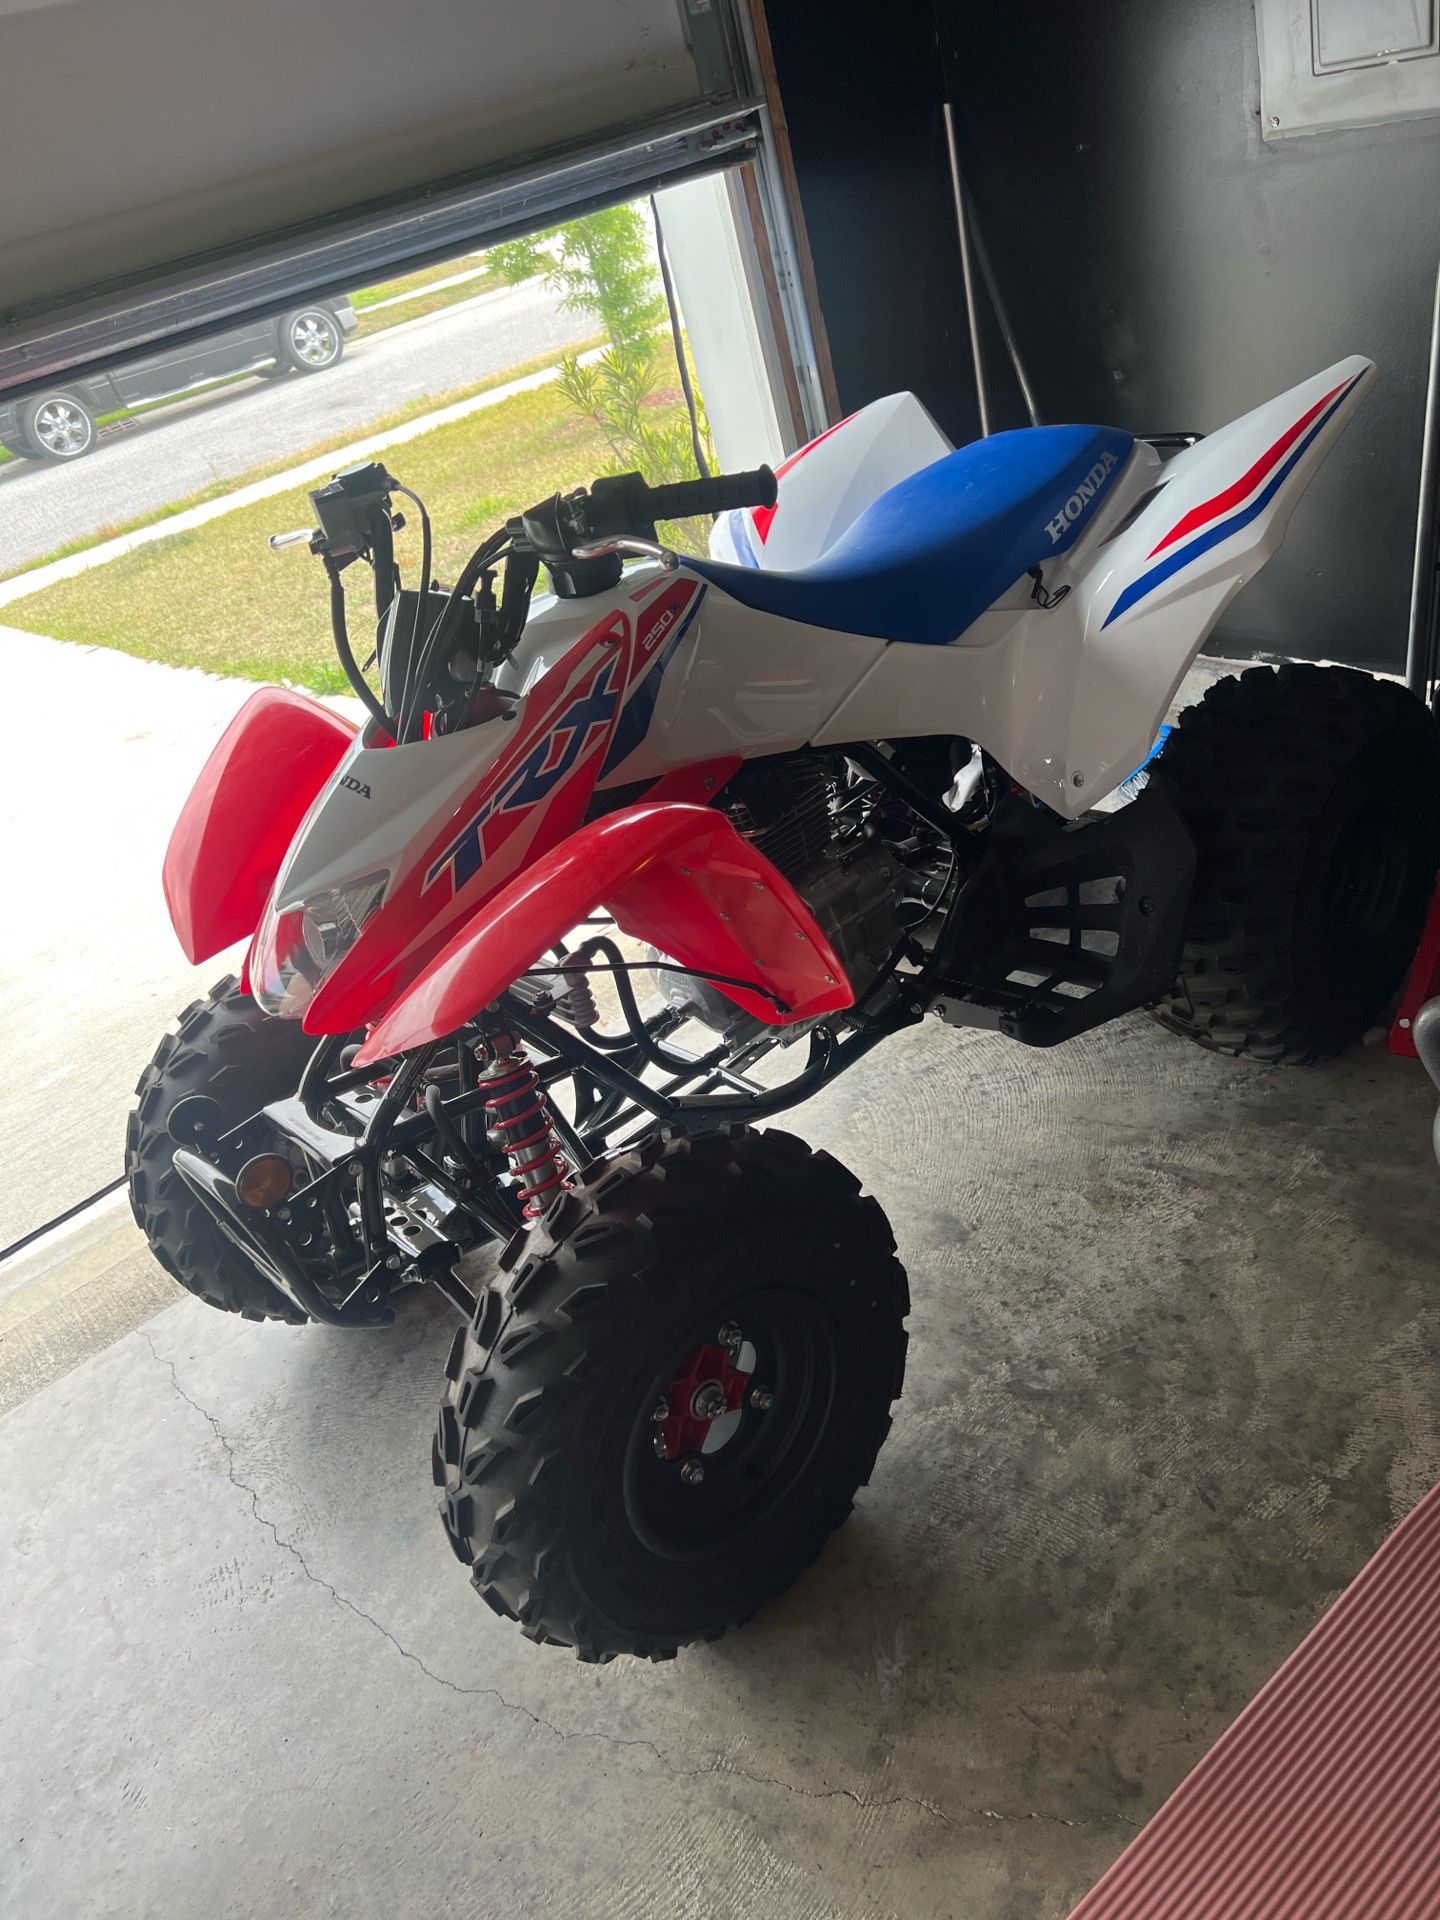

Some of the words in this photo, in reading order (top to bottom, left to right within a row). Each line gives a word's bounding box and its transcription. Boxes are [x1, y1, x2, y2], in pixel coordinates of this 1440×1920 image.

[1044, 451, 1118, 545] HONDA
[340, 775, 371, 800] NDA
[421, 652, 619, 895] TRX
